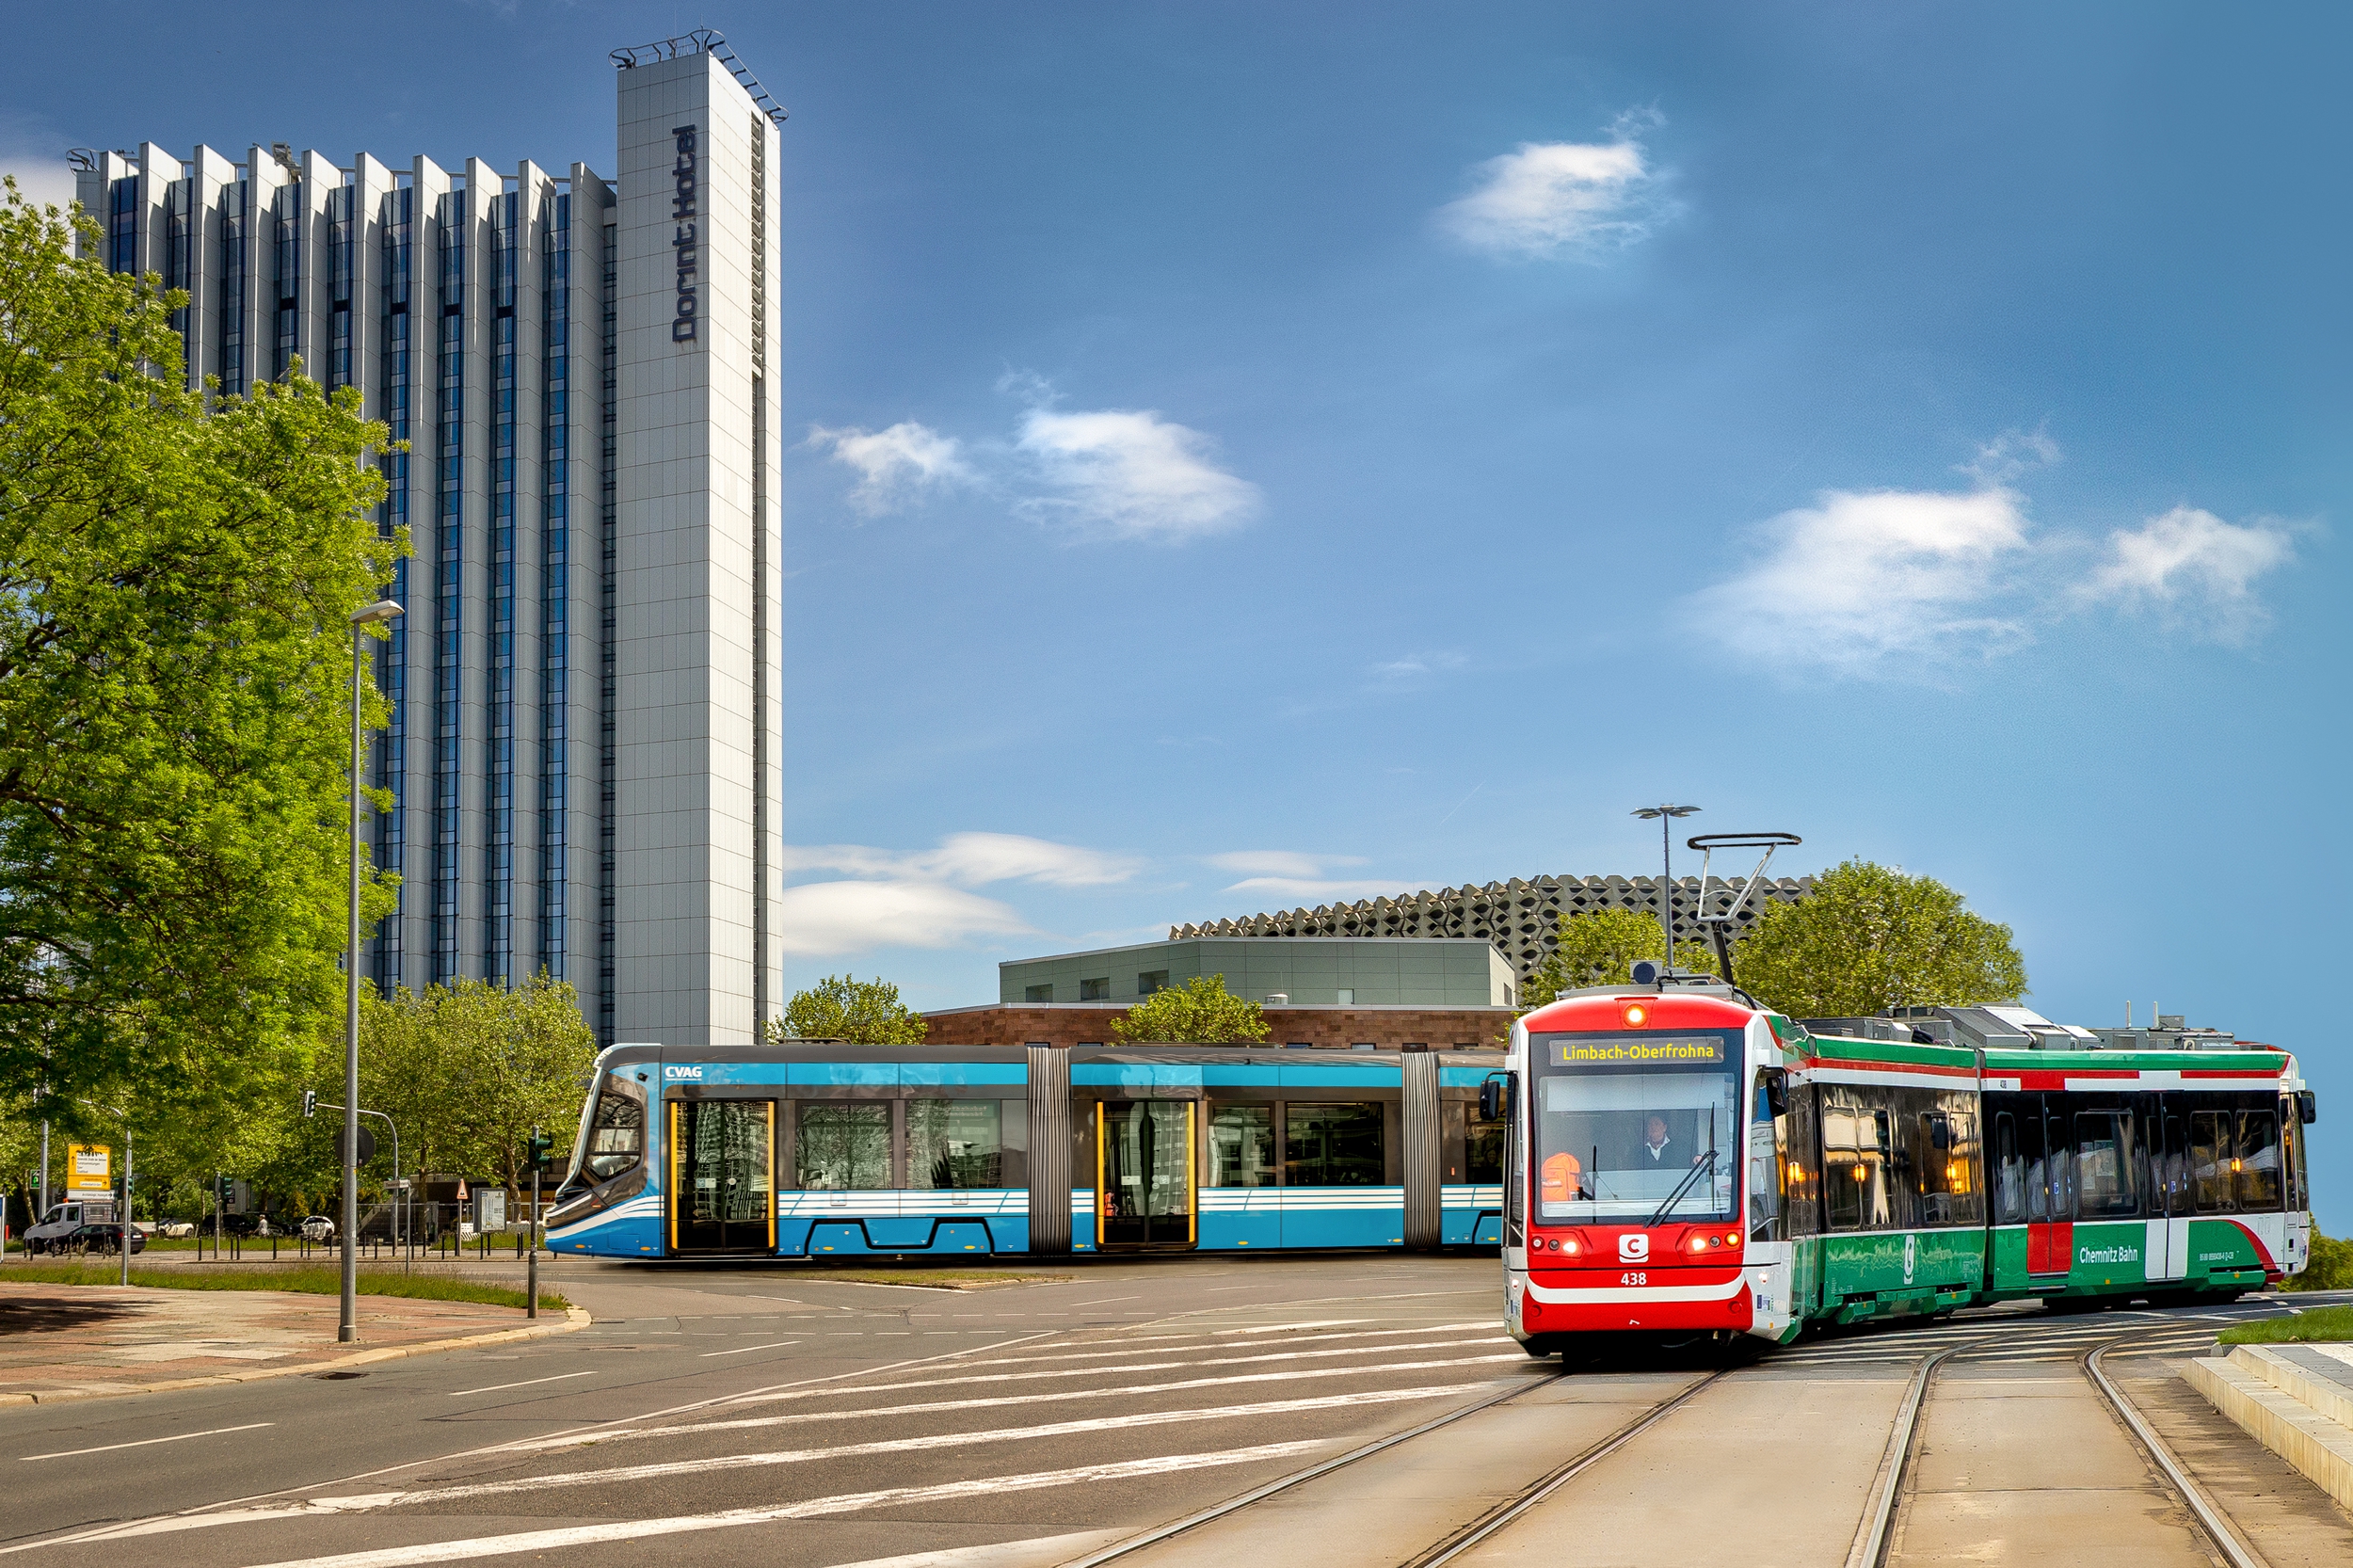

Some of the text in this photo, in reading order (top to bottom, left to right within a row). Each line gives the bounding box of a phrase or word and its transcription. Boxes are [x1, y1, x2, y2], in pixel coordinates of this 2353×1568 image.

[672, 124, 696, 342] Dorint Hotel
[1562, 1043, 1714, 1060] Limbach-Oberfrohna
[664, 1065, 702, 1078] CVAG
[2079, 1244, 2138, 1263] Chemnitz Bahn
[1621, 1272, 1647, 1286] 438
